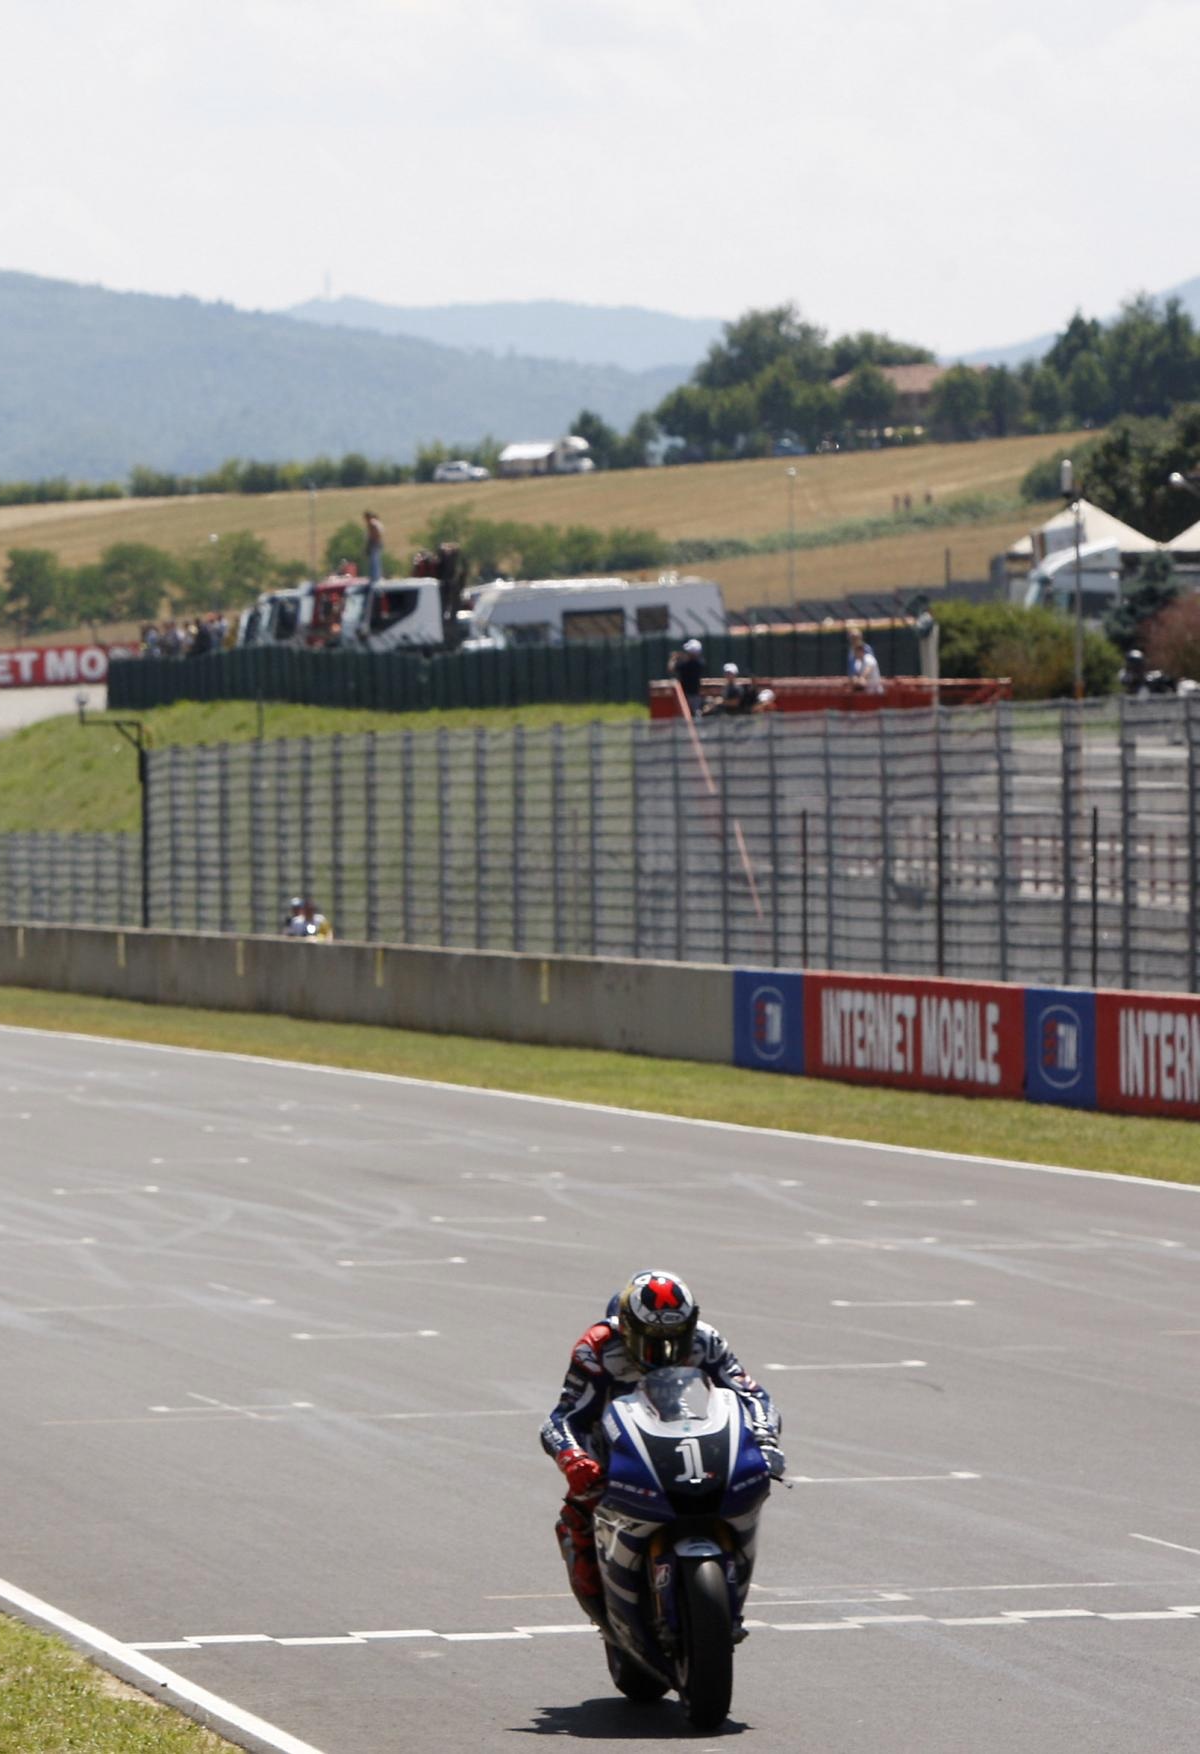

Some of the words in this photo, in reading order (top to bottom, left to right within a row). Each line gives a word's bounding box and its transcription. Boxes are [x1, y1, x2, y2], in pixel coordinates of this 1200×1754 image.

[820, 989, 917, 1074] INTERNET
[921, 996, 1002, 1086] MOBILE
[674, 1437, 706, 1482] 1
